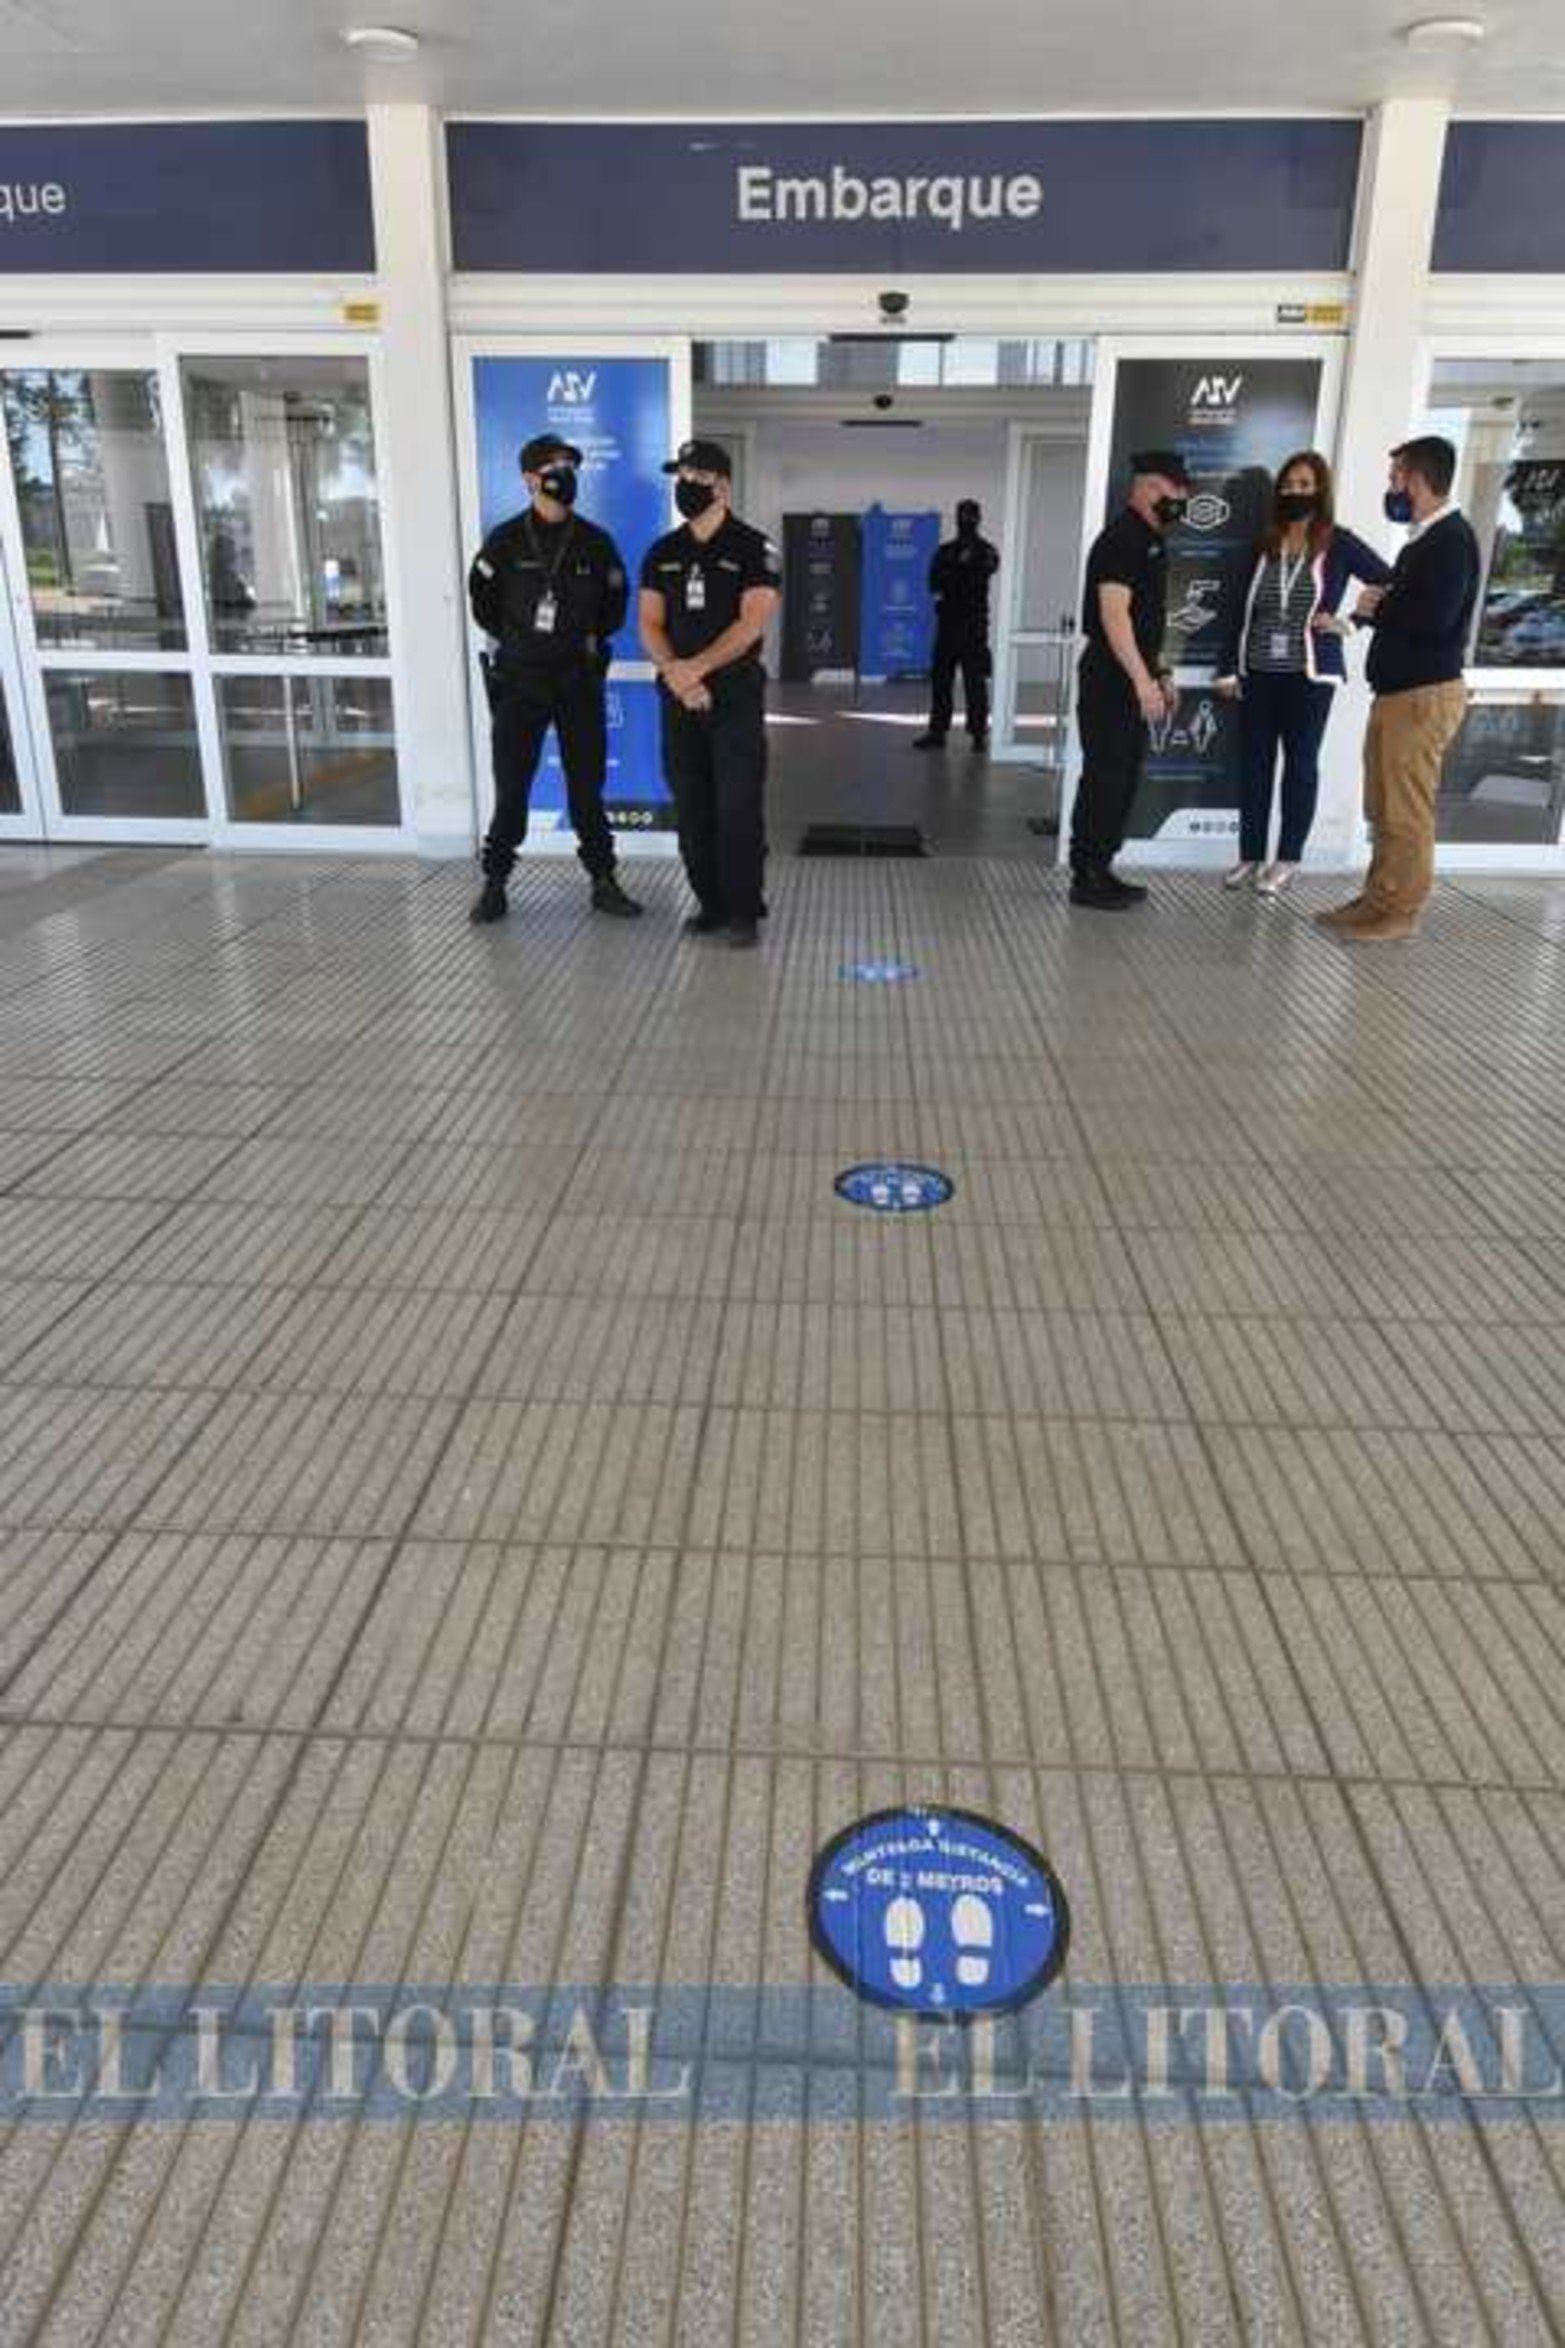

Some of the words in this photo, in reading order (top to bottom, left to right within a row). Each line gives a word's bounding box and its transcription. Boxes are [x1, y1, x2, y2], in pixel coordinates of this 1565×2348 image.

[737, 165, 1042, 230] Embarque
[866, 1866, 895, 1886] DE
[916, 1870, 1004, 1896] METROS
